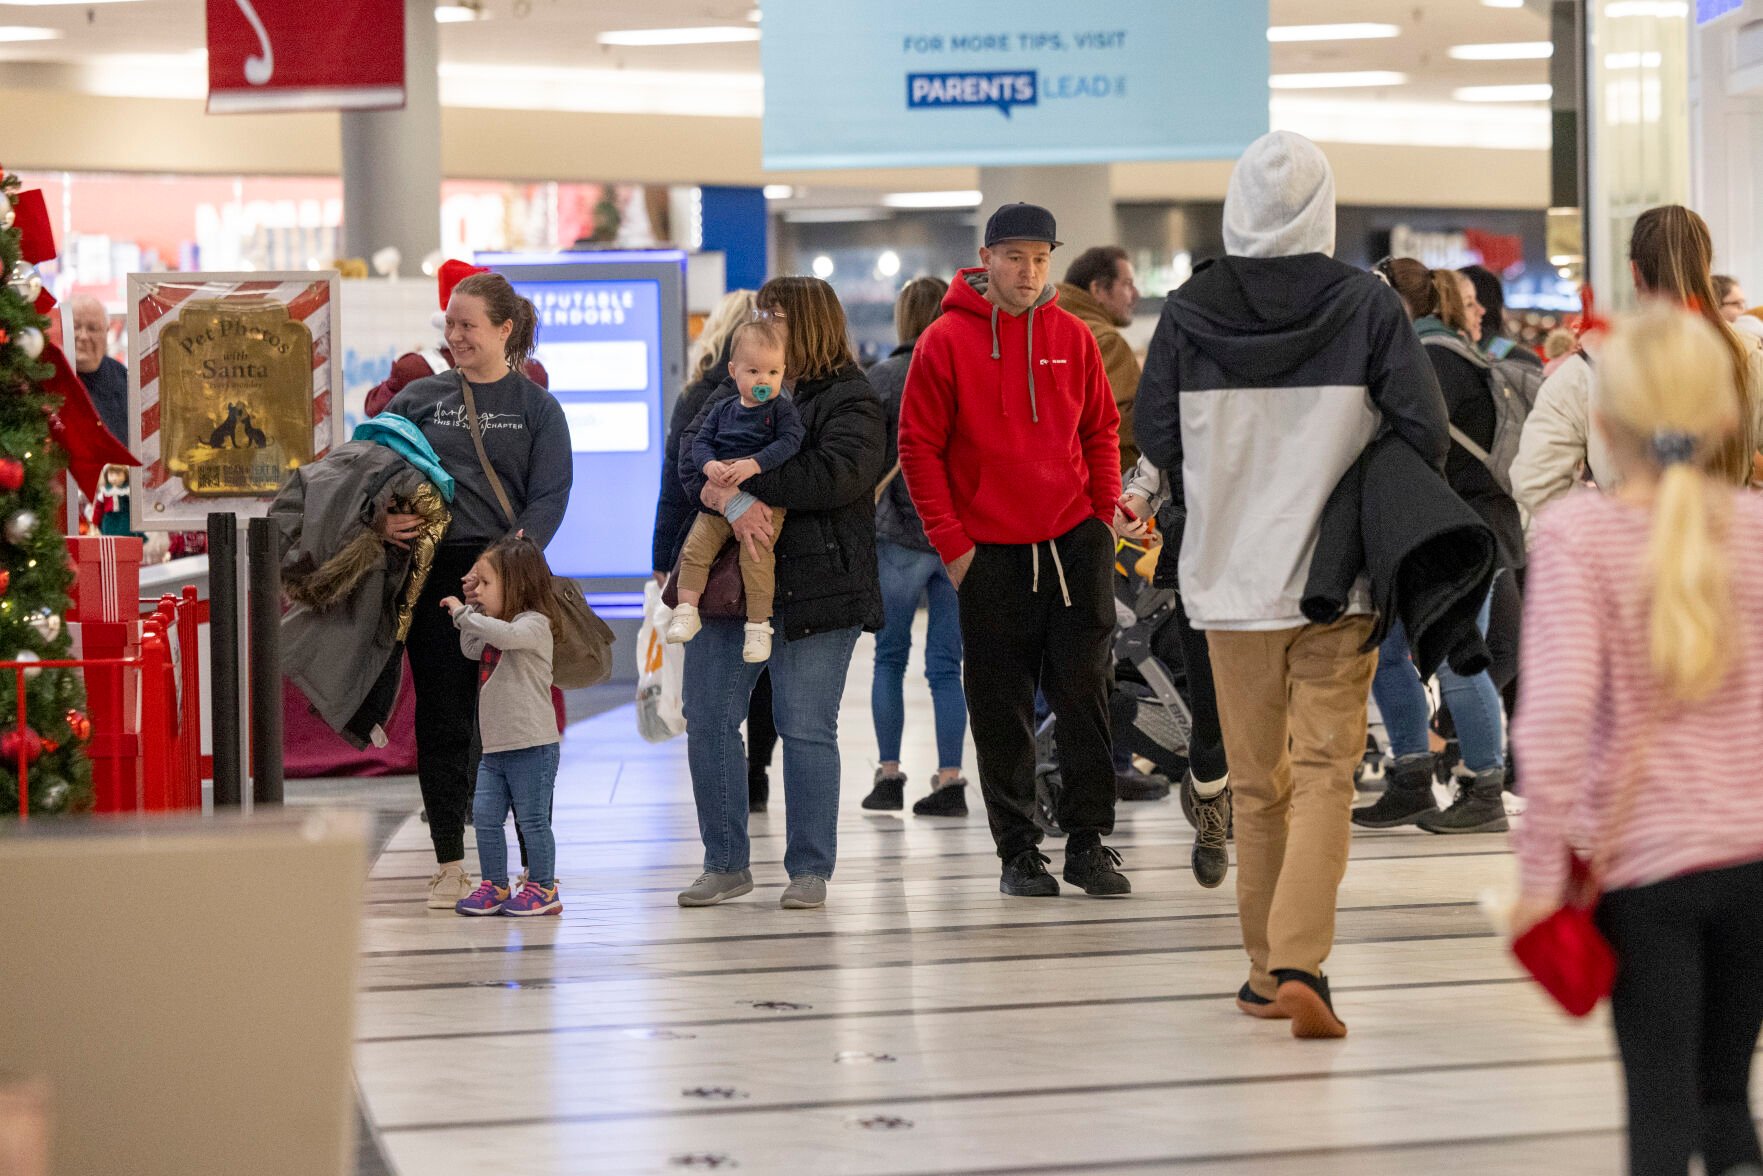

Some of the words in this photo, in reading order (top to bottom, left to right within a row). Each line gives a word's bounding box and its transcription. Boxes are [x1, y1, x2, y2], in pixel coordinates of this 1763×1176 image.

[903, 34, 944, 53] FOR
[951, 34, 1009, 52] MORE
[1074, 31, 1126, 49] VISIT
[912, 75, 1034, 103] PARENTS
[526, 288, 635, 309] EPUTABLE
[542, 307, 625, 326] ENDORS
[180, 327, 216, 356] Pet
[219, 319, 290, 354] Photos
[223, 351, 249, 361] with
[202, 359, 269, 379] Santa
